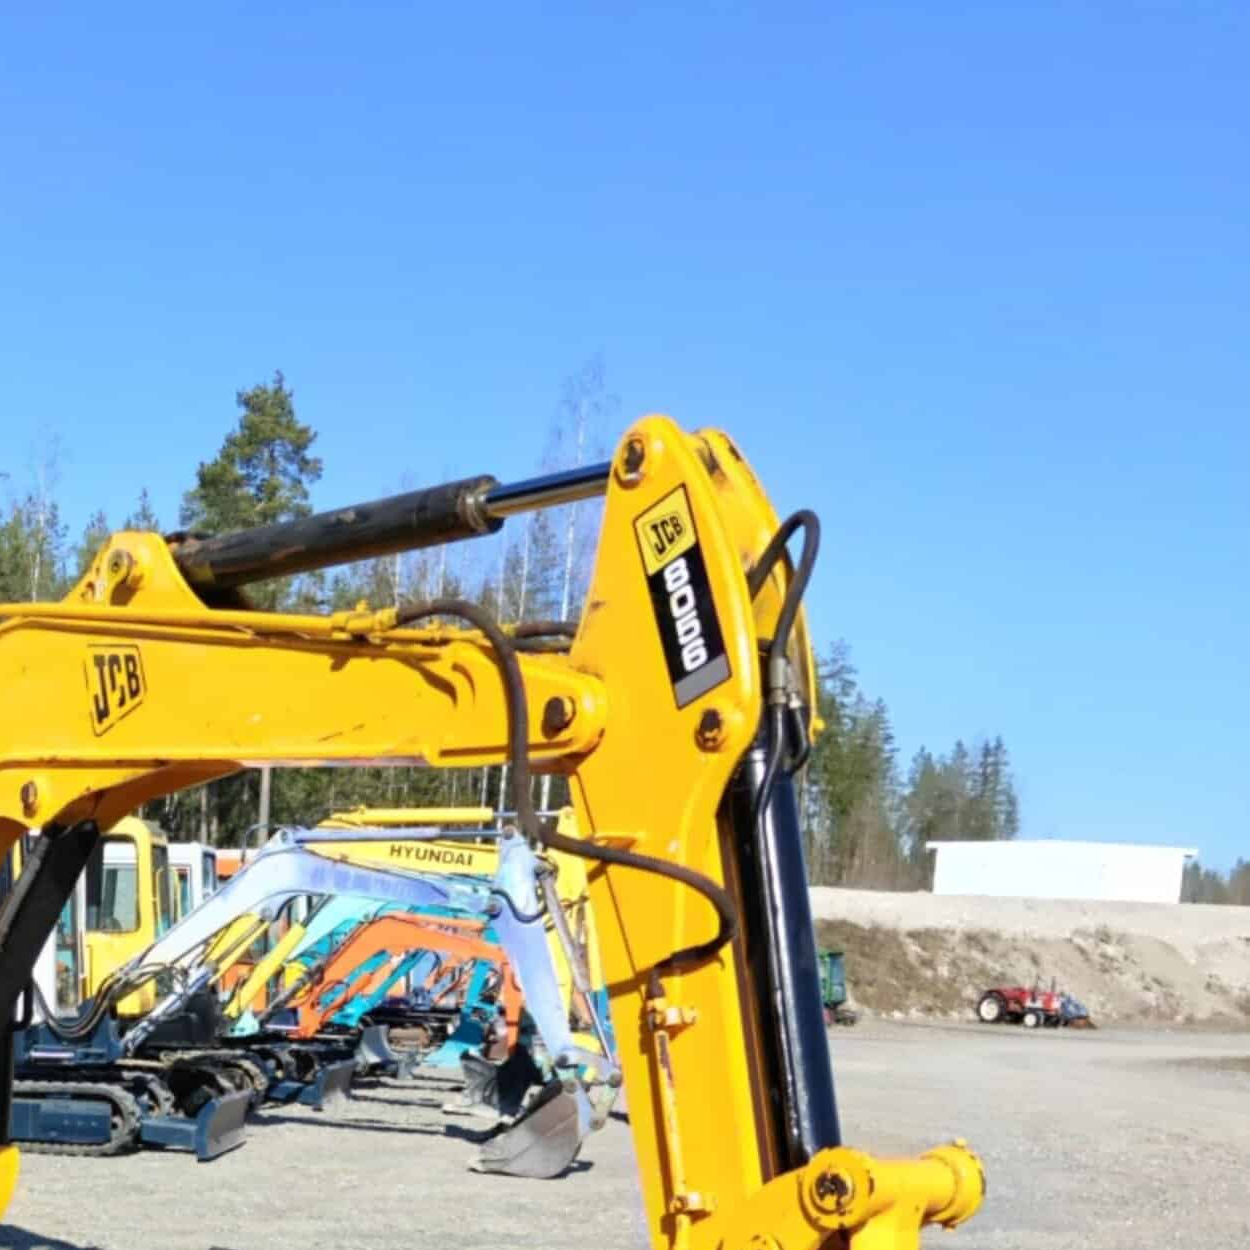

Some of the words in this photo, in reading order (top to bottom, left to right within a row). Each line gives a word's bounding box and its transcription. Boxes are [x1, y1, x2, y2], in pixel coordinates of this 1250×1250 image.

[650, 515, 684, 556] JCB
[663, 556, 708, 672] 8056
[93, 654, 141, 724] JCB
[390, 844, 474, 867] HYUNDAI
